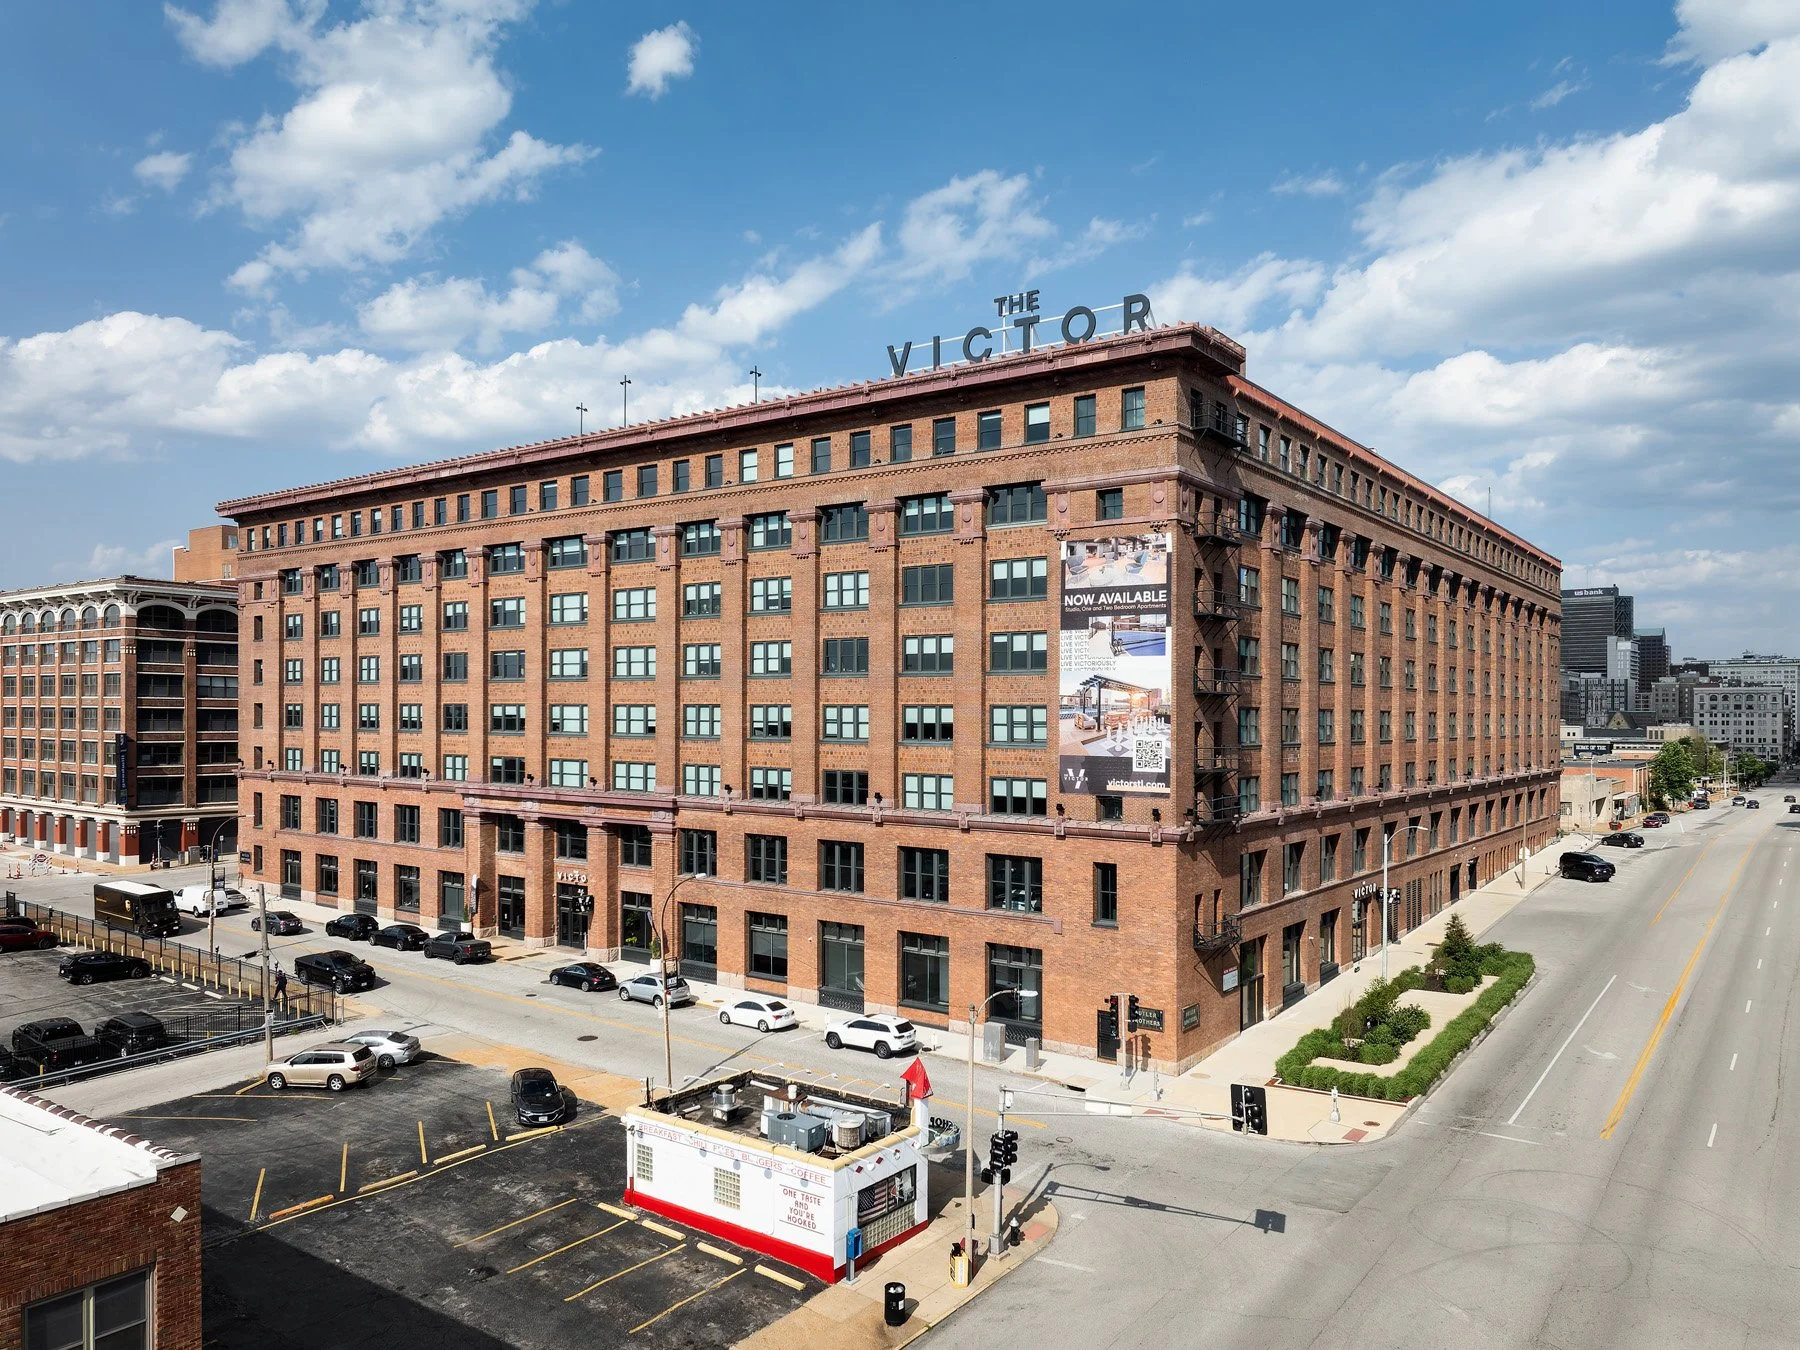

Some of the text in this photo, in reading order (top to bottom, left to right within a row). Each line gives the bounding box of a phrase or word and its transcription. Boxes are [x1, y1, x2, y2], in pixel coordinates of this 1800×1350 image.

[993, 289, 1040, 317] THE
[886, 293, 1151, 377] VICTOR
[1064, 590, 1167, 606] NOW AVAILABLE
[1107, 778, 1165, 789] victorstl.com
[557, 871, 587, 882] VICTO
[1354, 883, 1376, 899] VICTOR
[638, 1124, 682, 1141] BREAKFAST
[791, 1168, 826, 1184] COFFEE
[783, 1188, 821, 1206] ONE TASTE
[794, 1200, 809, 1210] AND
[789, 1206, 815, 1221] YOU'RE
[787, 1214, 817, 1230] HOOKED
